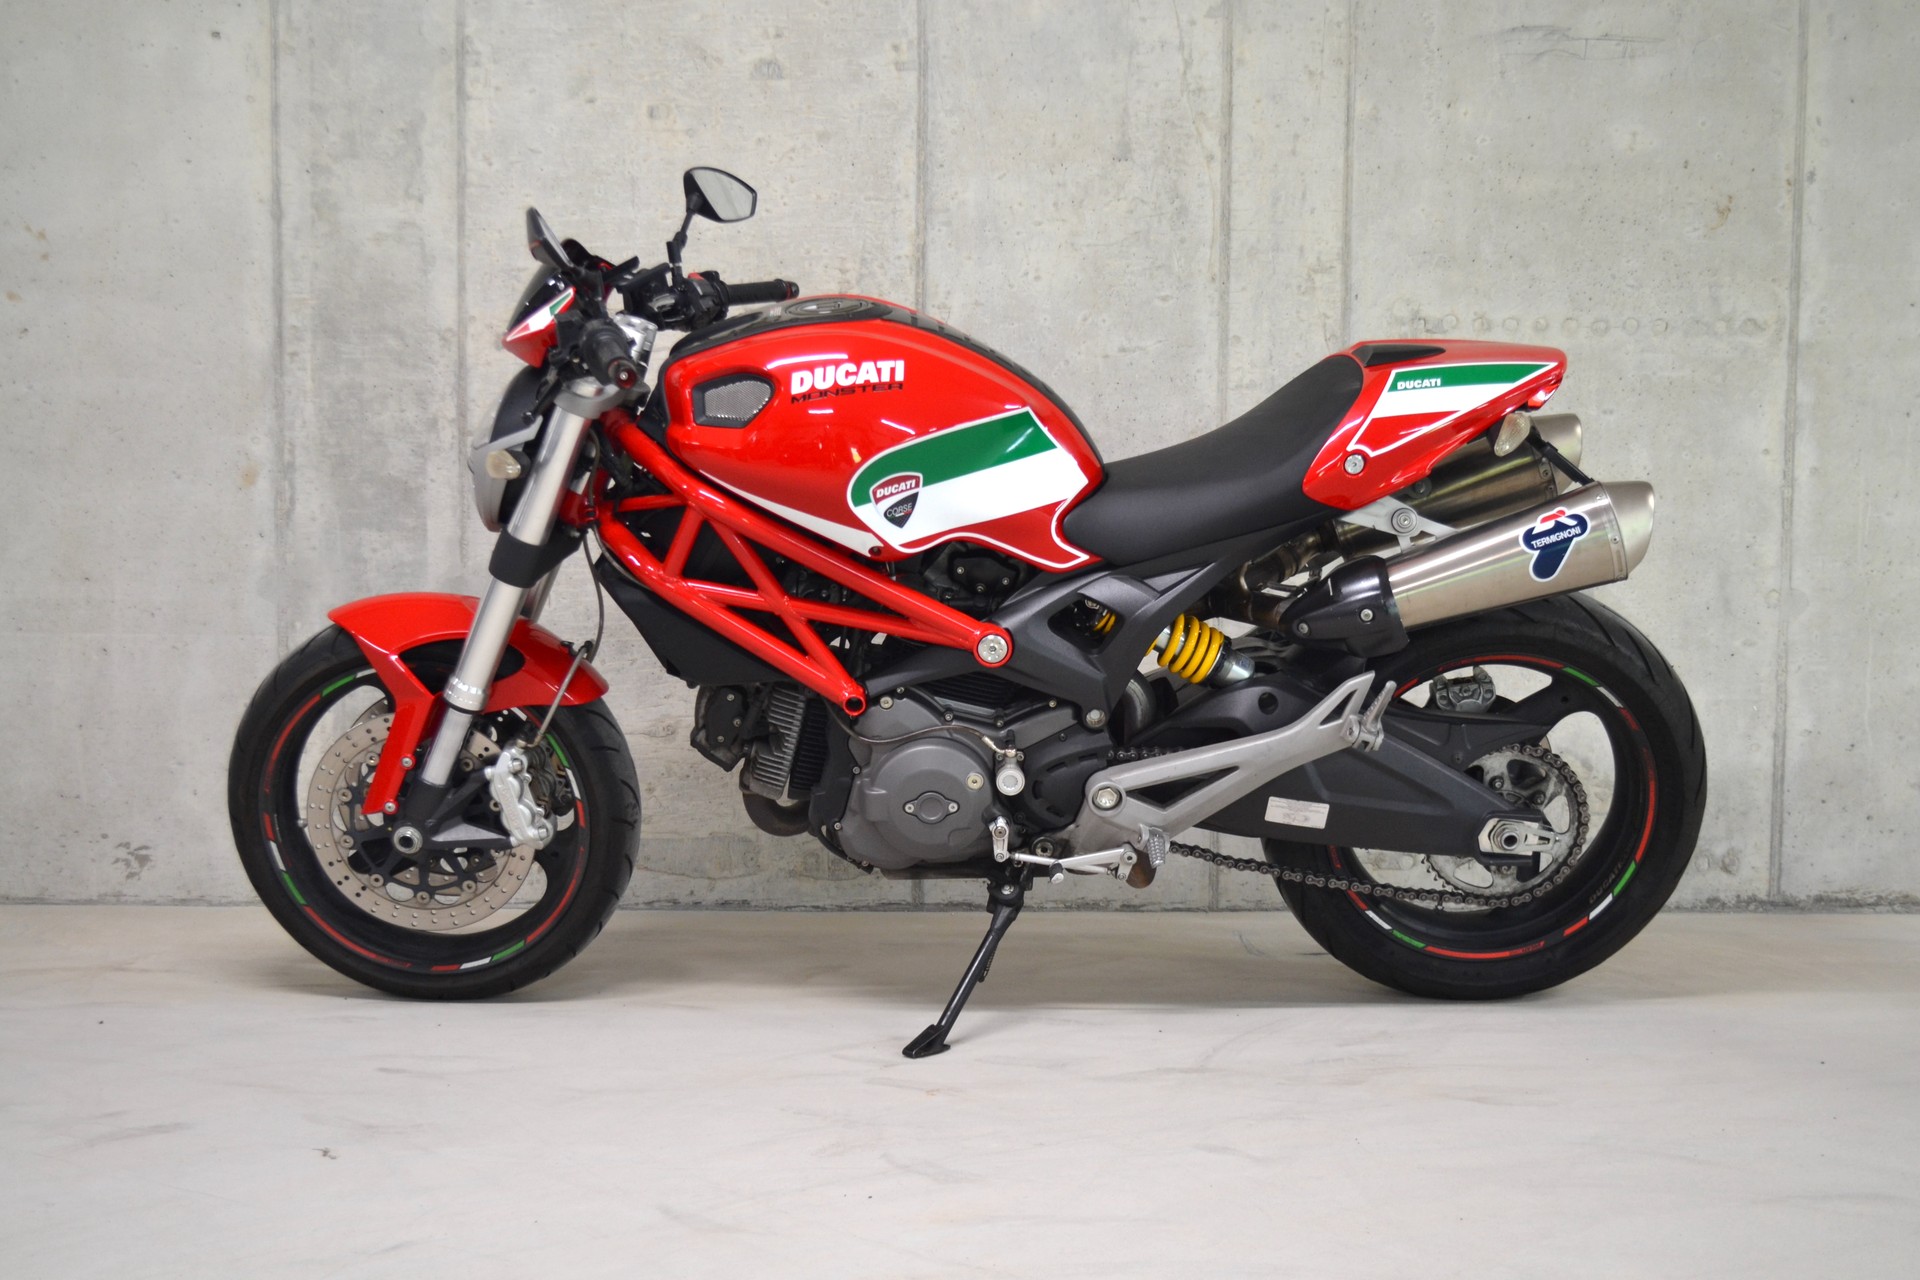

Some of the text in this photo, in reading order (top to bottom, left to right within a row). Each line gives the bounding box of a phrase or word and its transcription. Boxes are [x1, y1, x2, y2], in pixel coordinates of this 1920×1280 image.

[791, 359, 905, 395] DUCATI
[1397, 378, 1442, 390] DUCATI
[791, 383, 903, 404] MONSTER
[876, 479, 916, 498] DUCATI
[886, 502, 913, 517] CORSE
[1531, 526, 1581, 549] TERMIGNONI
